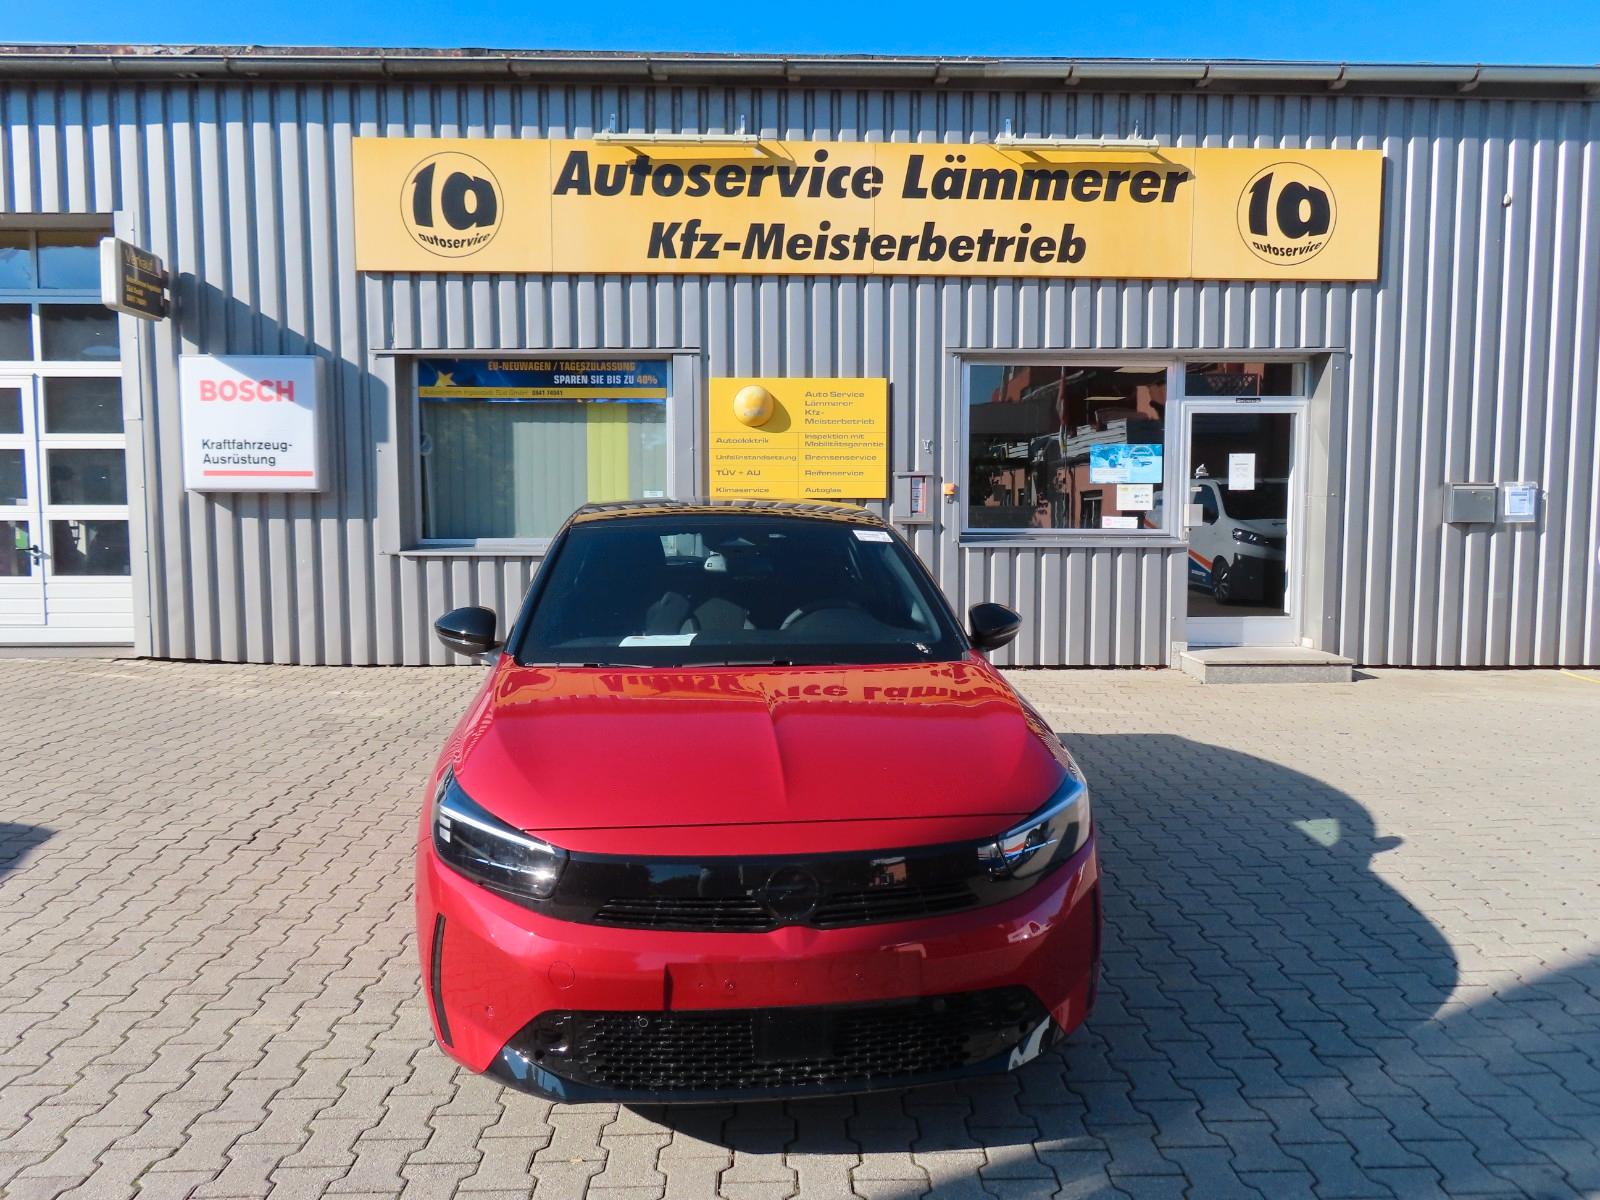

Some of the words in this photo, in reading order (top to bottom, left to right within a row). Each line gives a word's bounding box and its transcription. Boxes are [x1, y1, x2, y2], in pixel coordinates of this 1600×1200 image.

[553, 149, 884, 199] Autoservice
[901, 153, 1189, 203] Lämmerer
[411, 161, 498, 231] 1a
[1248, 171, 1331, 240] 1a
[418, 232, 491, 249] autoservice
[647, 218, 1087, 264] Kfz-Meisterbetrieb
[1252, 241, 1323, 257] autoservice
[560, 361, 636, 372] TAGESZULASSUNG
[553, 374, 588, 385] SPAREN
[590, 374, 605, 385] SIE
[606, 374, 622, 385] BIS
[623, 374, 635, 385] ZU
[636, 375, 658, 385] 40%
[199, 379, 295, 402] BOSCH
[805, 433, 849, 441] Inspektion
[202, 439, 293, 452] Kraftfahrzeug-
[203, 453, 277, 467] Ausrüstung
[716, 467, 736, 476] TÜV
[805, 487, 842, 495] Autoglas
